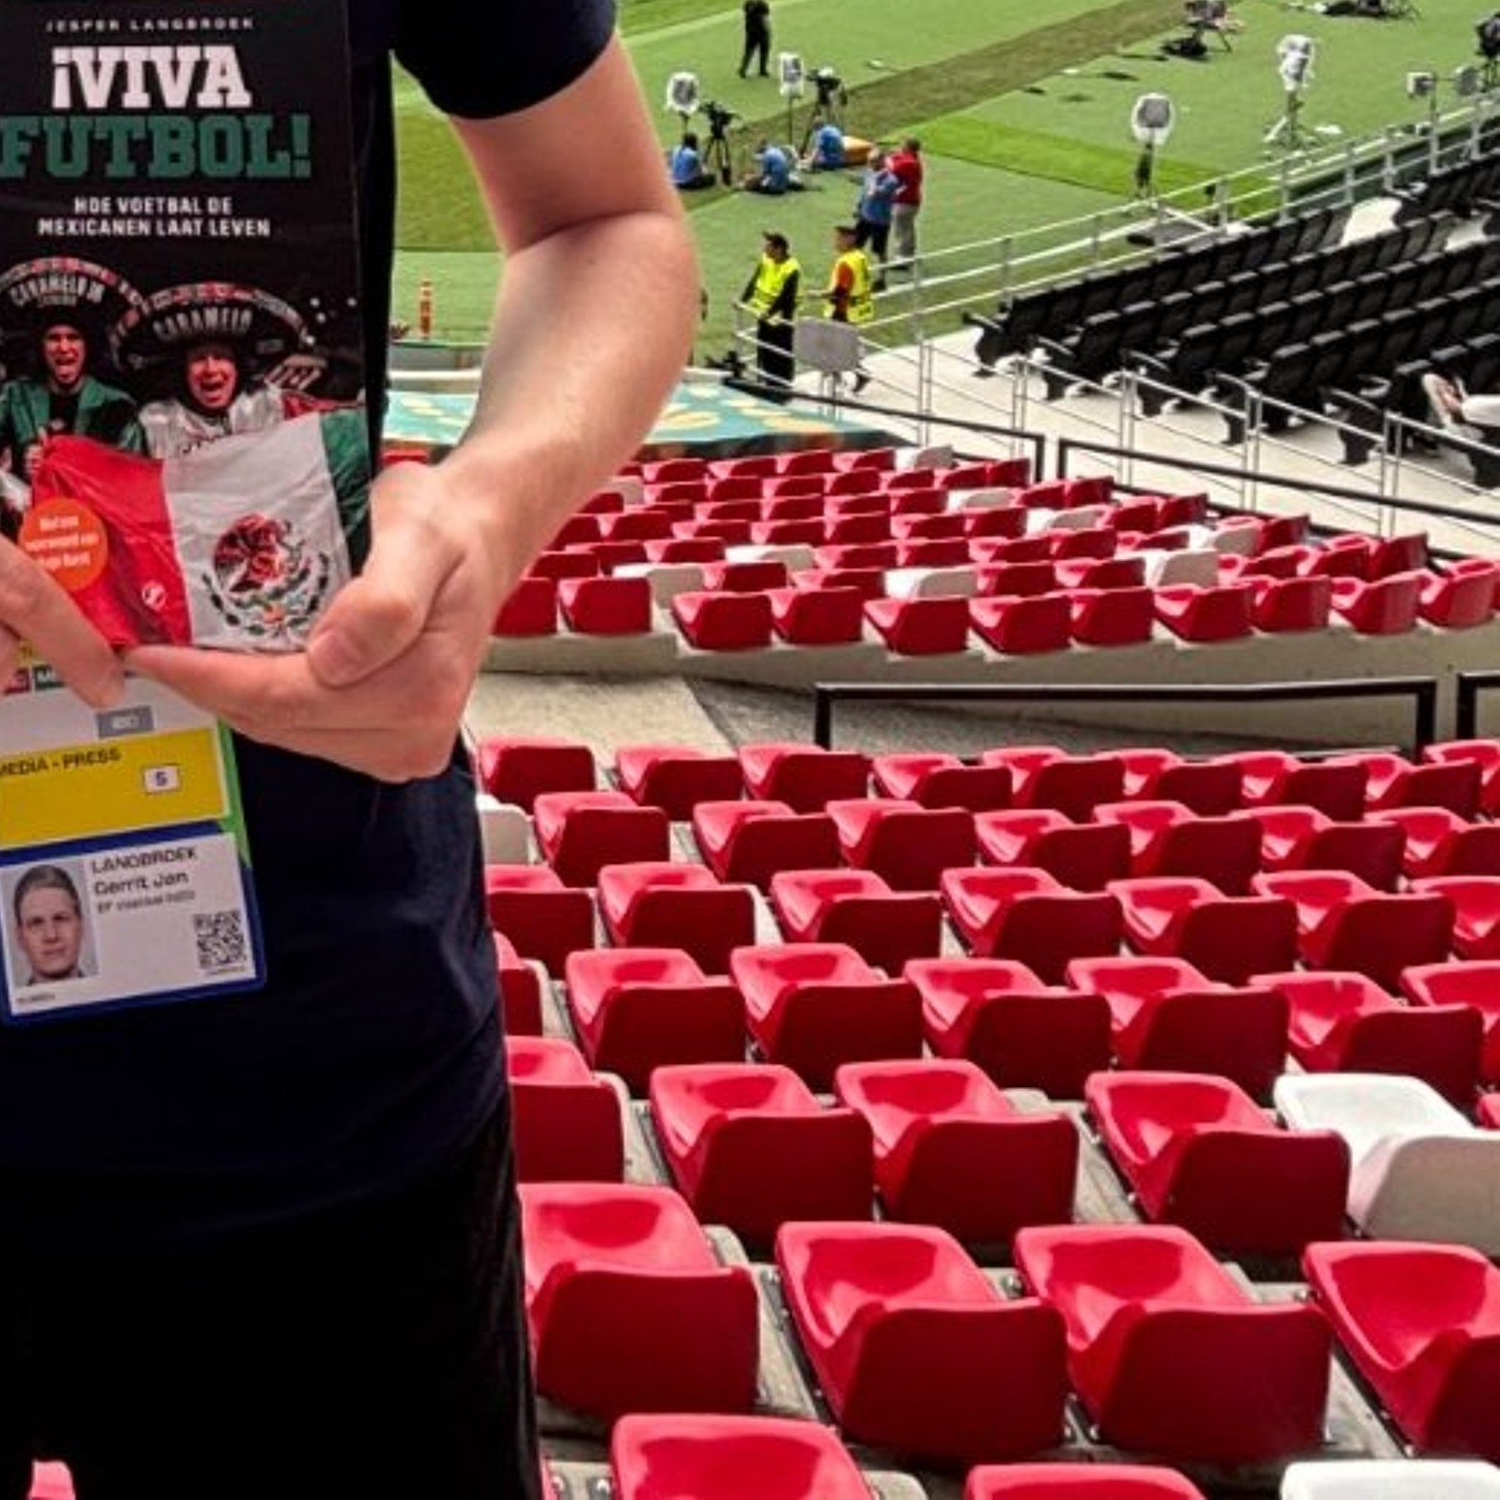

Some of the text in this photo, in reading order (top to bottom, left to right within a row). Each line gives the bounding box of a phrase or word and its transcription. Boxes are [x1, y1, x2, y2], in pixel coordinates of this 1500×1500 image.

[46, 19, 119, 33] JESPER
[74, 196, 233, 215] HOE VOETBAL DE
[38, 218, 271, 237] MEXICANEN LAAT LEVEN
[62, 748, 122, 771] PRESS
[94, 872, 190, 897] Gerrit Jan
